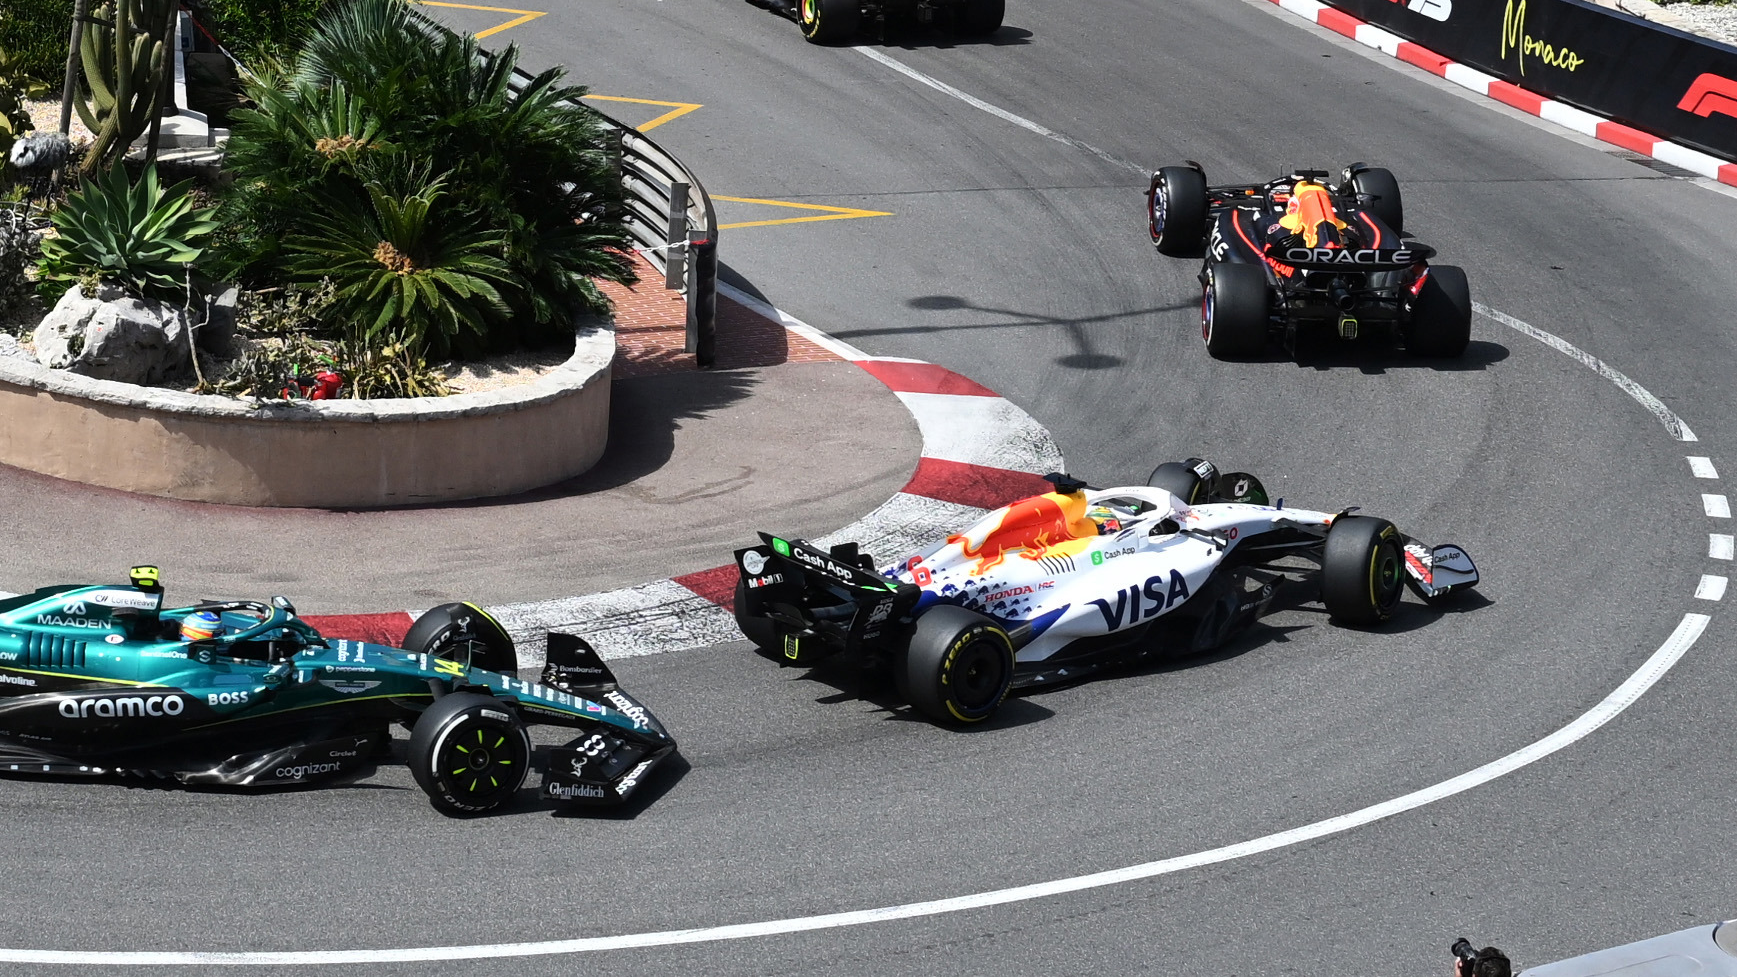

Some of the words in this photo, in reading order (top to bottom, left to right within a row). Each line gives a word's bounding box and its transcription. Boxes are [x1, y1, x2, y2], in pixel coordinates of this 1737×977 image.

[1286, 247, 1413, 264] ORACLE
[1104, 549, 1121, 560] Cash
[1121, 546, 1136, 557] App
[793, 547, 825, 569] Cash
[827, 560, 853, 580] App
[748, 575, 774, 589] Mobil
[111, 595, 156, 608] CoreWeave
[984, 585, 1034, 602] HONDA
[1084, 568, 1190, 632] VISA
[37, 613, 112, 630] MAADEN
[140, 650, 188, 660] SentinelOne
[944, 632, 971, 671] ZERO
[335, 665, 376, 673] pepperstone
[559, 665, 603, 674] Bombardier
[58, 694, 185, 718] aramco
[207, 690, 249, 706] BOSS
[276, 760, 342, 780] cognizant
[549, 782, 605, 798] Glenfiddich
